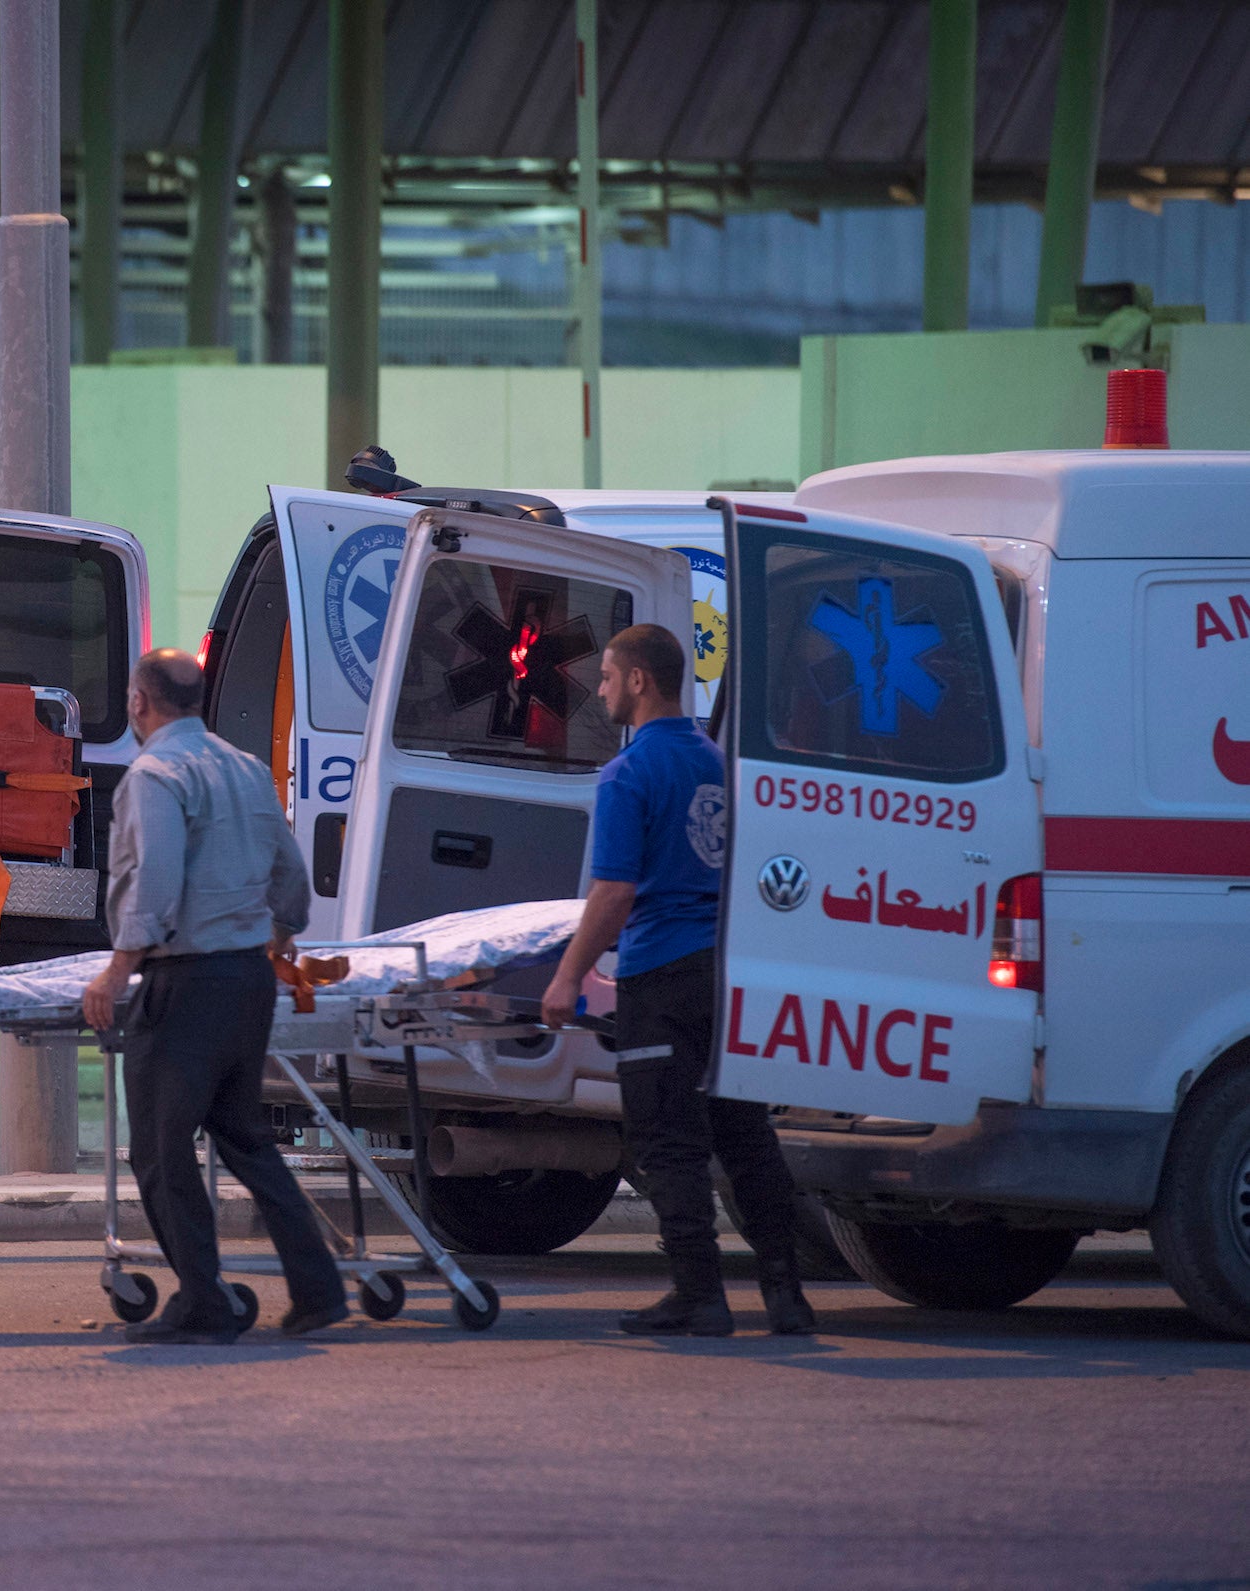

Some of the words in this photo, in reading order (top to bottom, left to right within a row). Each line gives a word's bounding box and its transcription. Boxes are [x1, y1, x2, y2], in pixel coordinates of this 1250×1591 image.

[754, 775, 977, 832] 0598102929
[821, 866, 987, 940] اسعاف
[726, 987, 954, 1083] LANCE
